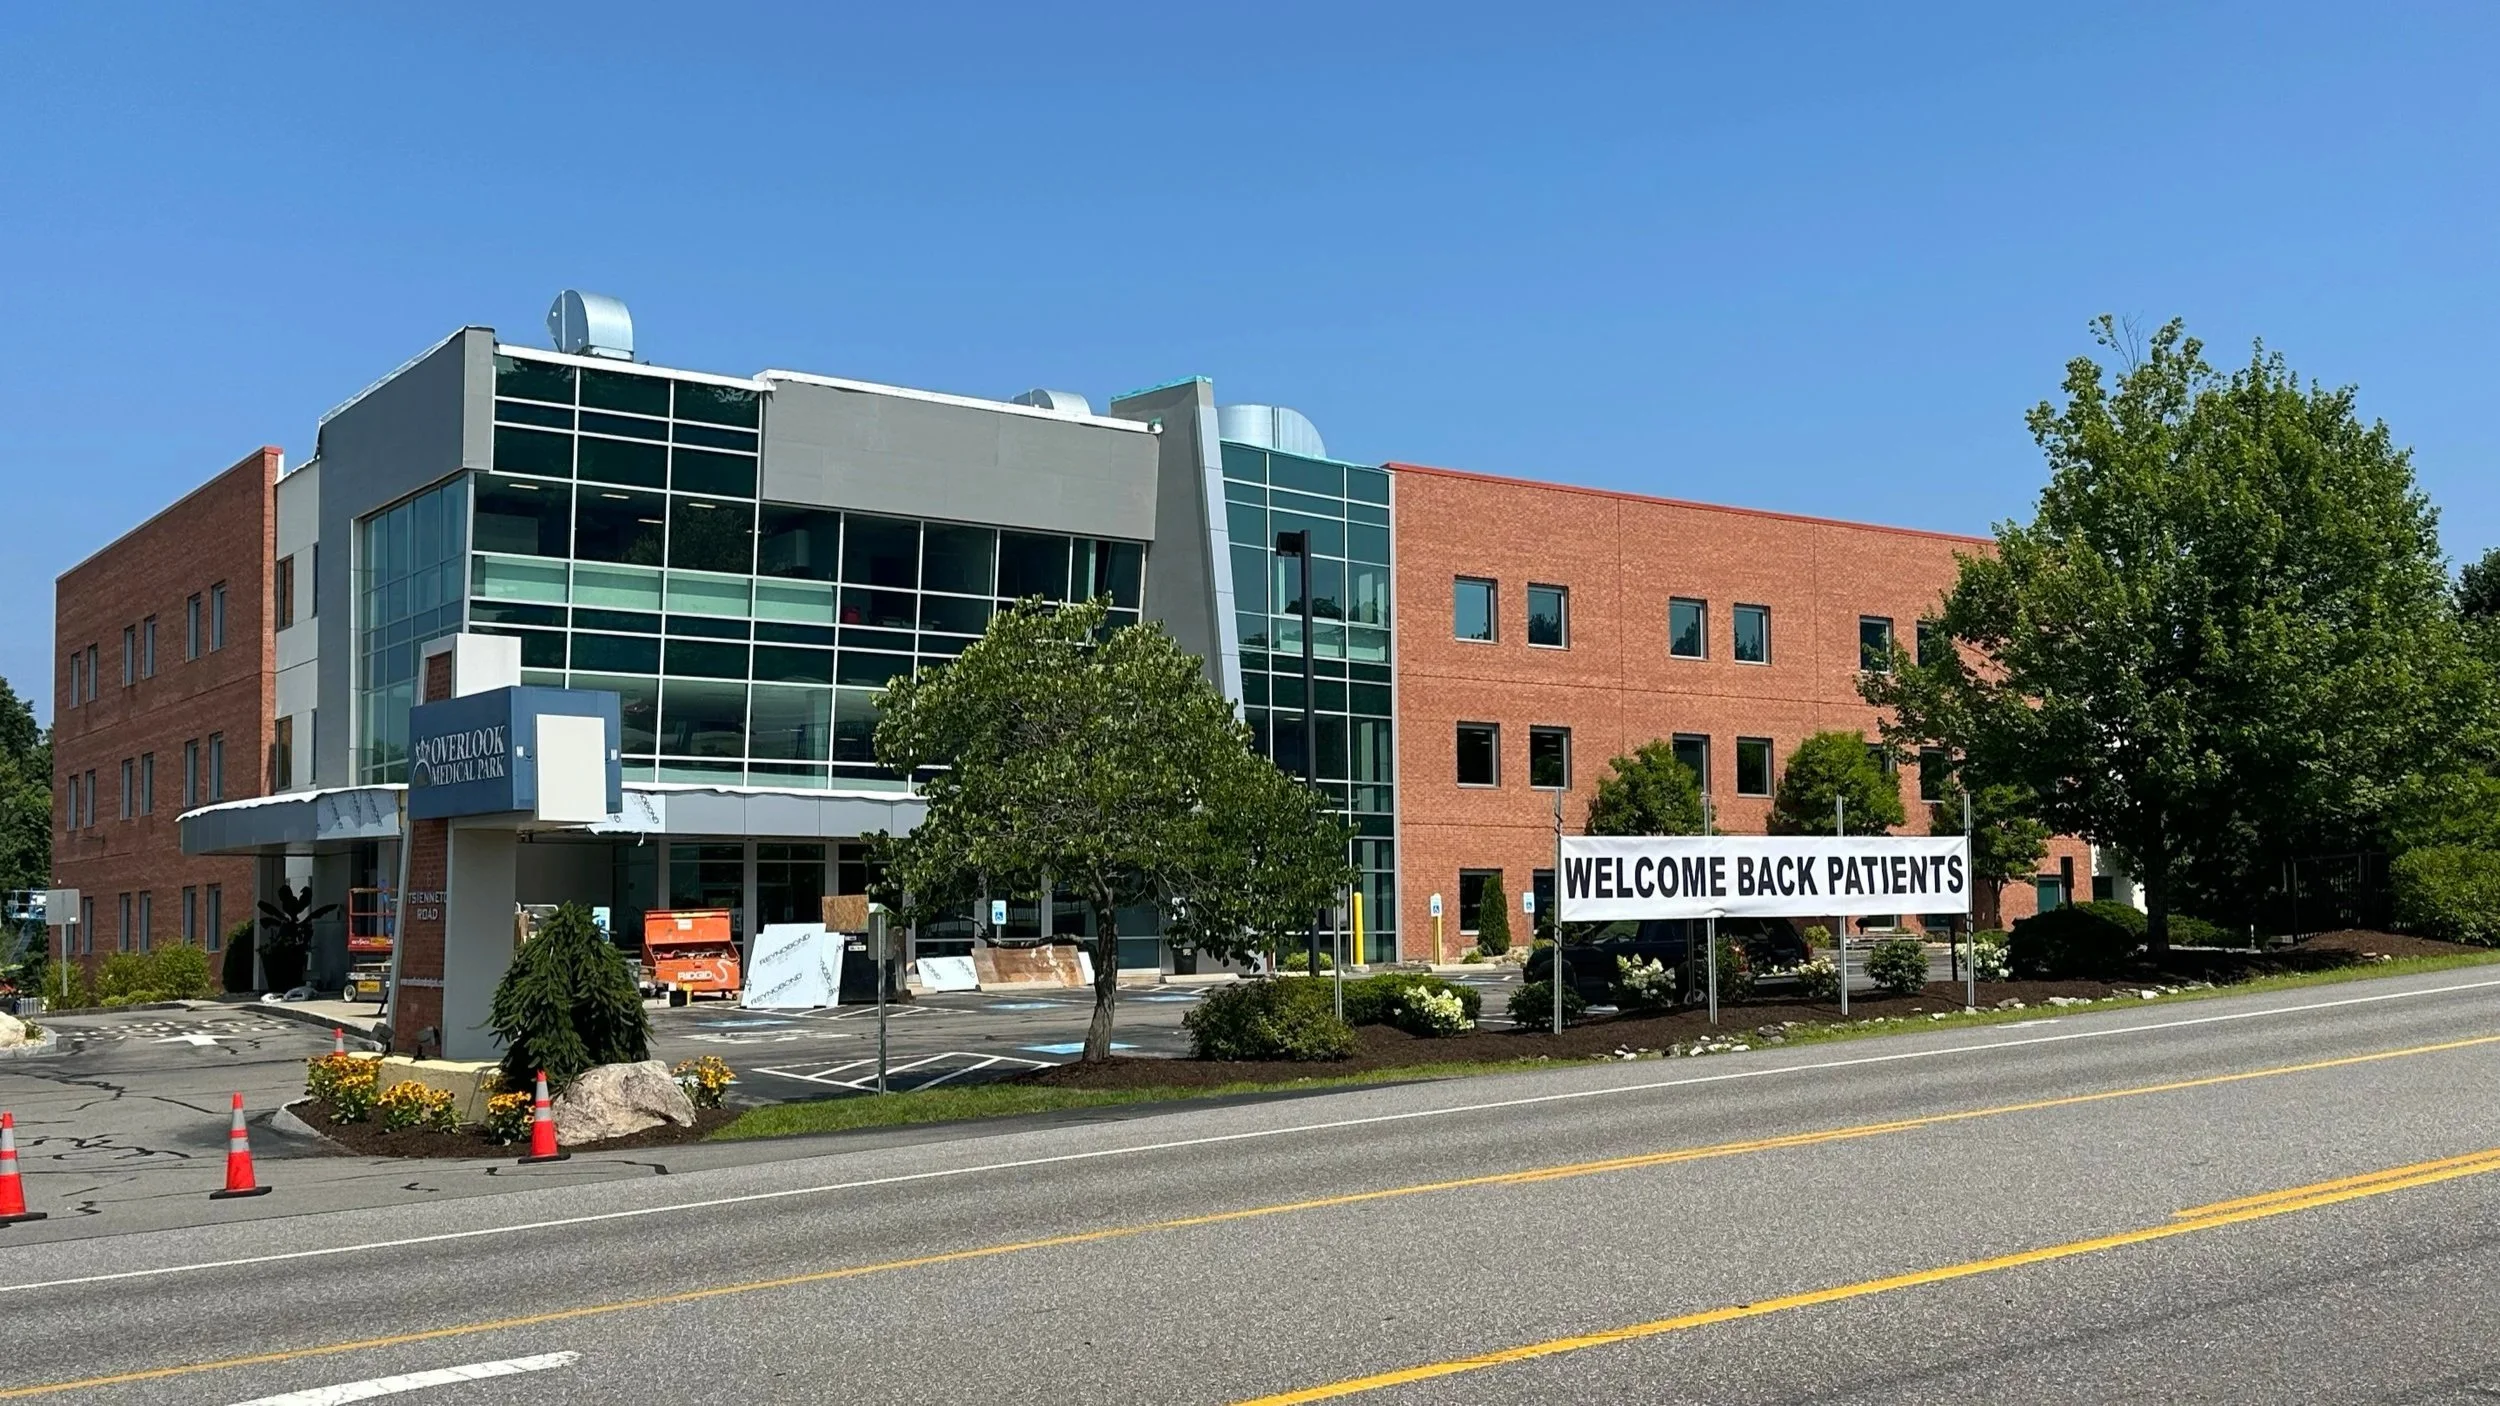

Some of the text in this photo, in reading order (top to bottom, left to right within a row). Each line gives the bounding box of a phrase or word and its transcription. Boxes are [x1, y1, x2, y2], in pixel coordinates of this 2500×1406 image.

[431, 725, 505, 765] OVERLOOK
[431, 755, 505, 787] MEDICAL PARK
[1565, 855, 1964, 899] WELCOME BACK PATIENTS
[416, 907, 439, 920] ROAD
[759, 933, 811, 965] REYNOBOND
[677, 970, 713, 981] RIDGID
[750, 972, 803, 1005] REYNOBOND
